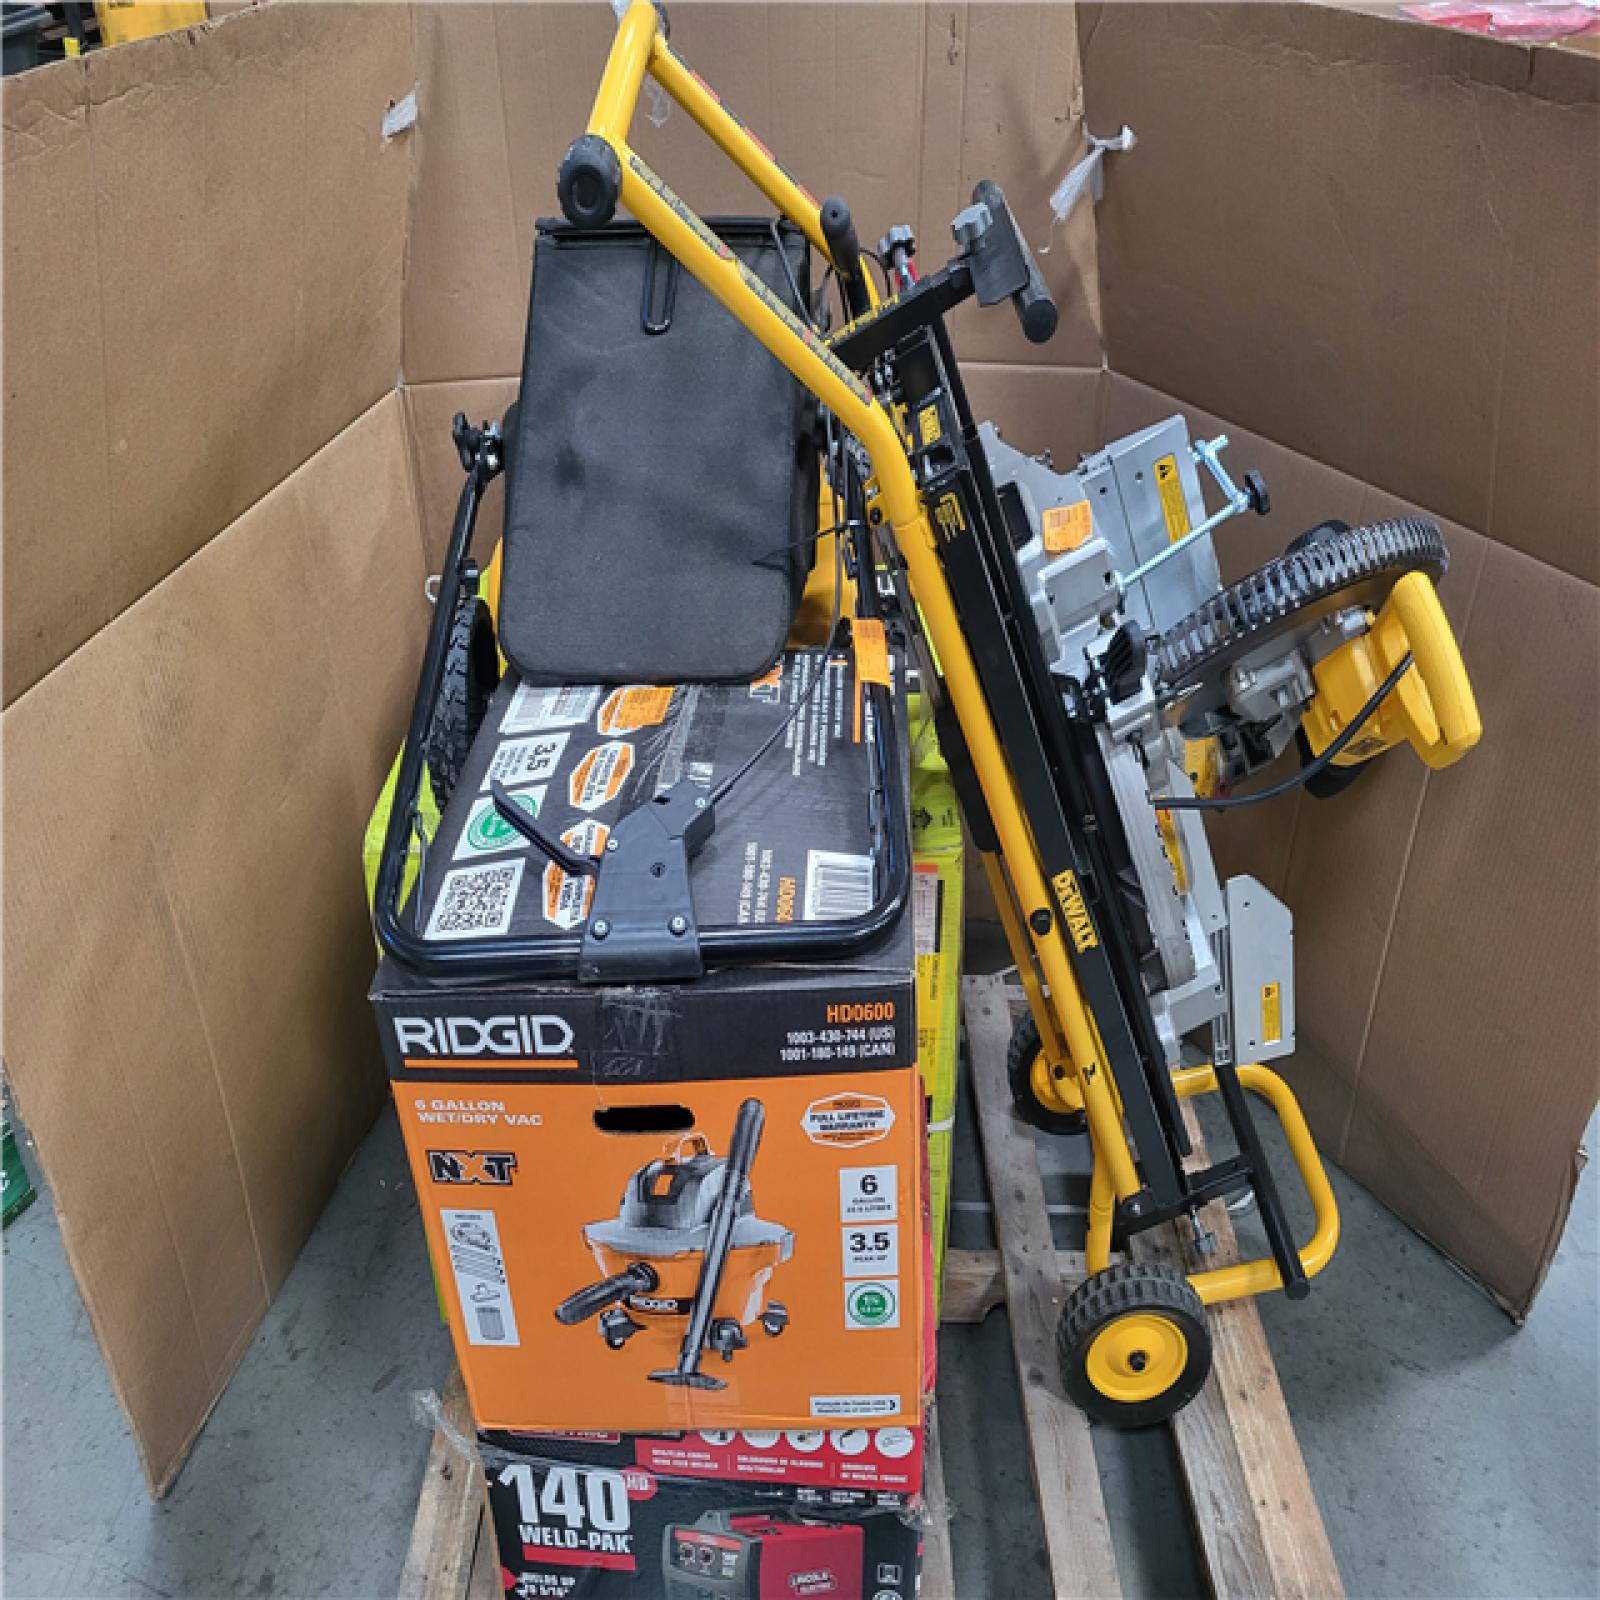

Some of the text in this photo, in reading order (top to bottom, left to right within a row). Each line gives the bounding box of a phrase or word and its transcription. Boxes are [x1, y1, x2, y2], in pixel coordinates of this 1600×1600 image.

[1051, 868, 1098, 953] DEWALT
[826, 1002, 896, 1024] HD0600
[393, 1015, 575, 1054] RIDGID
[431, 1099, 506, 1112] GALLON
[417, 1112, 544, 1127] WET/DRY VAC
[426, 1150, 518, 1185] NXT
[859, 1174, 879, 1196] 6
[849, 1231, 891, 1253] 3.5
[498, 1464, 631, 1531] 140
[518, 1523, 633, 1555] WELD-PAK
